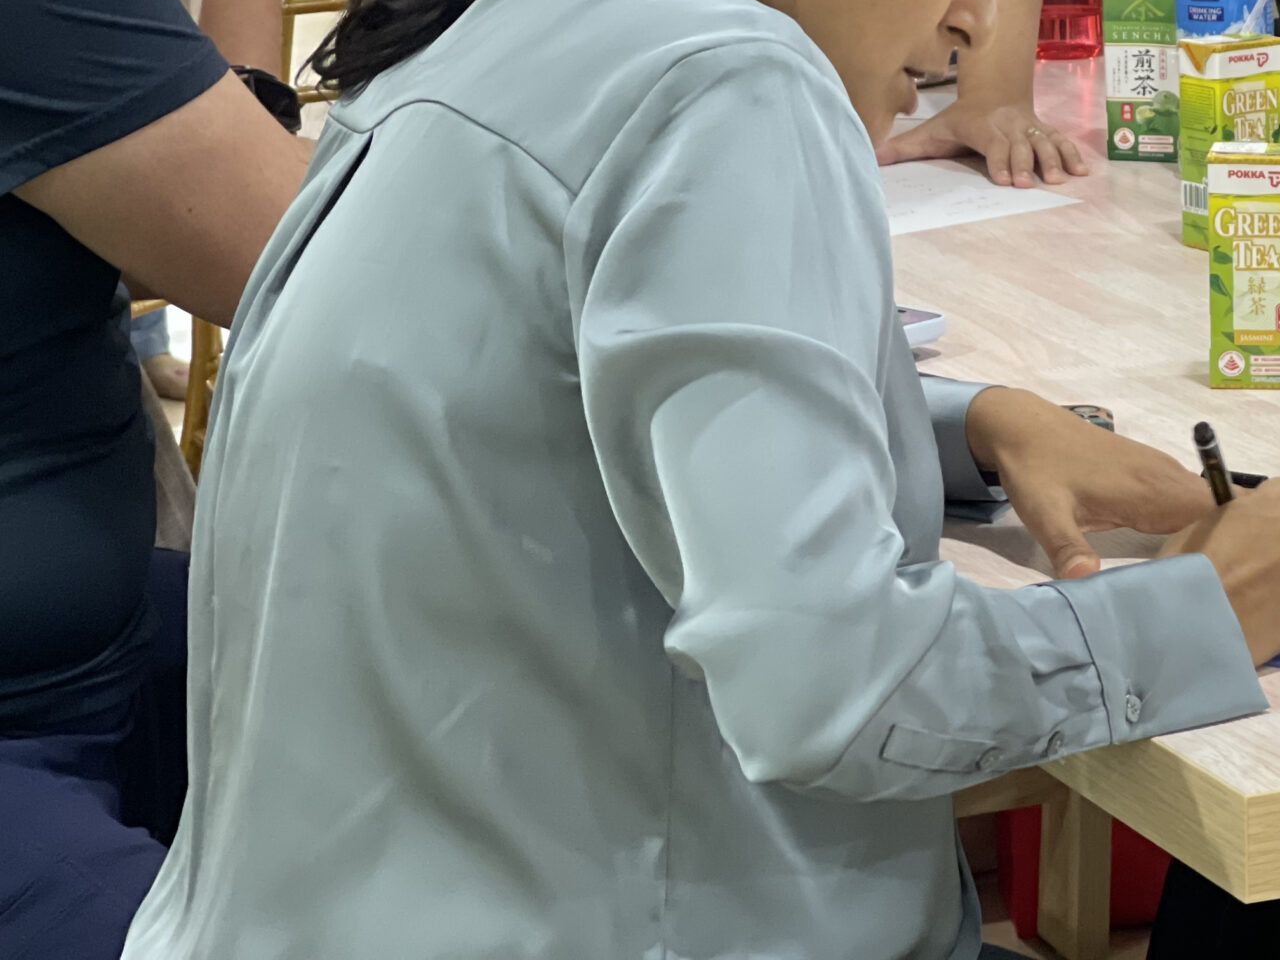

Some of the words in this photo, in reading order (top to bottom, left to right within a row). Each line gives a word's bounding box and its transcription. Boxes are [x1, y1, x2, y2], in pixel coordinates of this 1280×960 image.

[1188, 6, 1222, 15] DRINKING
[1112, 31, 1171, 41] SENCHA
[1228, 54, 1255, 64] POKKA
[1130, 48, 1159, 96] 煎茶
[1222, 88, 1279, 117] GREEN
[1233, 116, 1266, 142] TEA
[1227, 170, 1266, 179] POKKA
[1232, 239, 1280, 271] TEA
